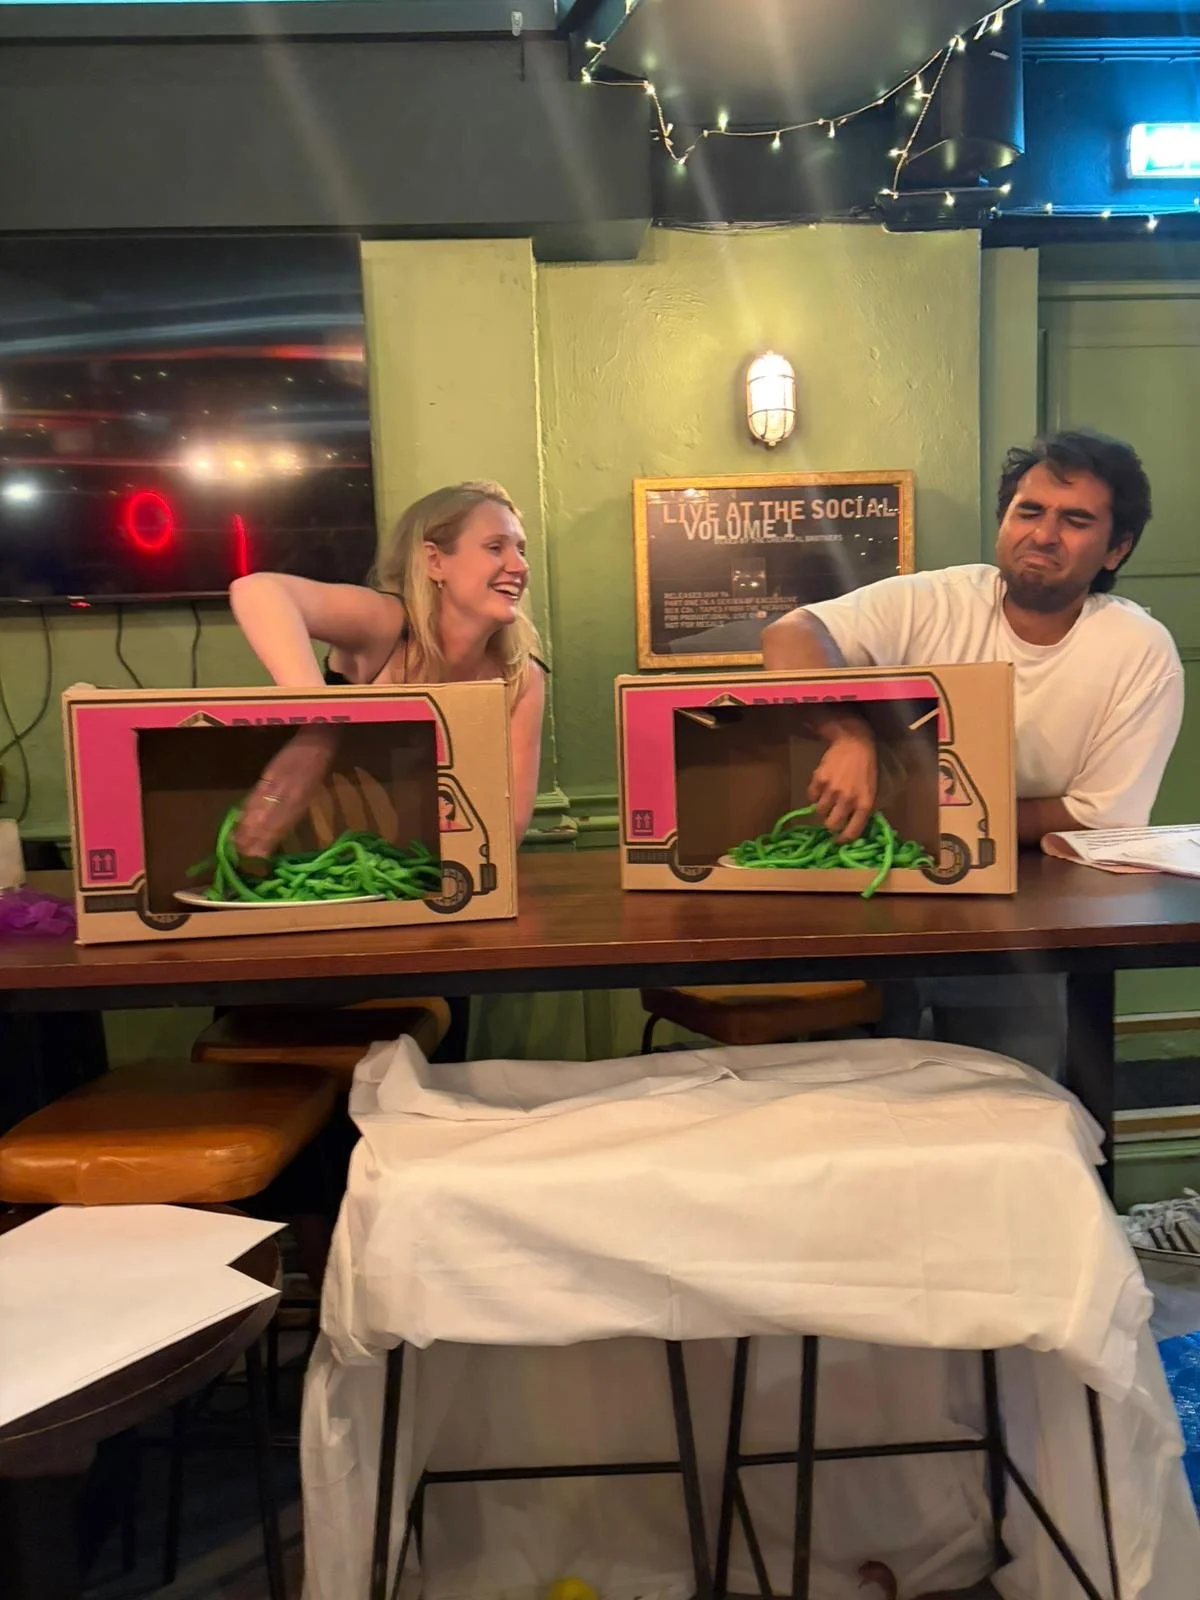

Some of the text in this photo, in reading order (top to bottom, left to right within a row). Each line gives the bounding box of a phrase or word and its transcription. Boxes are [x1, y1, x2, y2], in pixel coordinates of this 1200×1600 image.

[662, 497, 897, 523] LIVE AT THE SOCIAL
[683, 518, 795, 540] VOLUME 1
